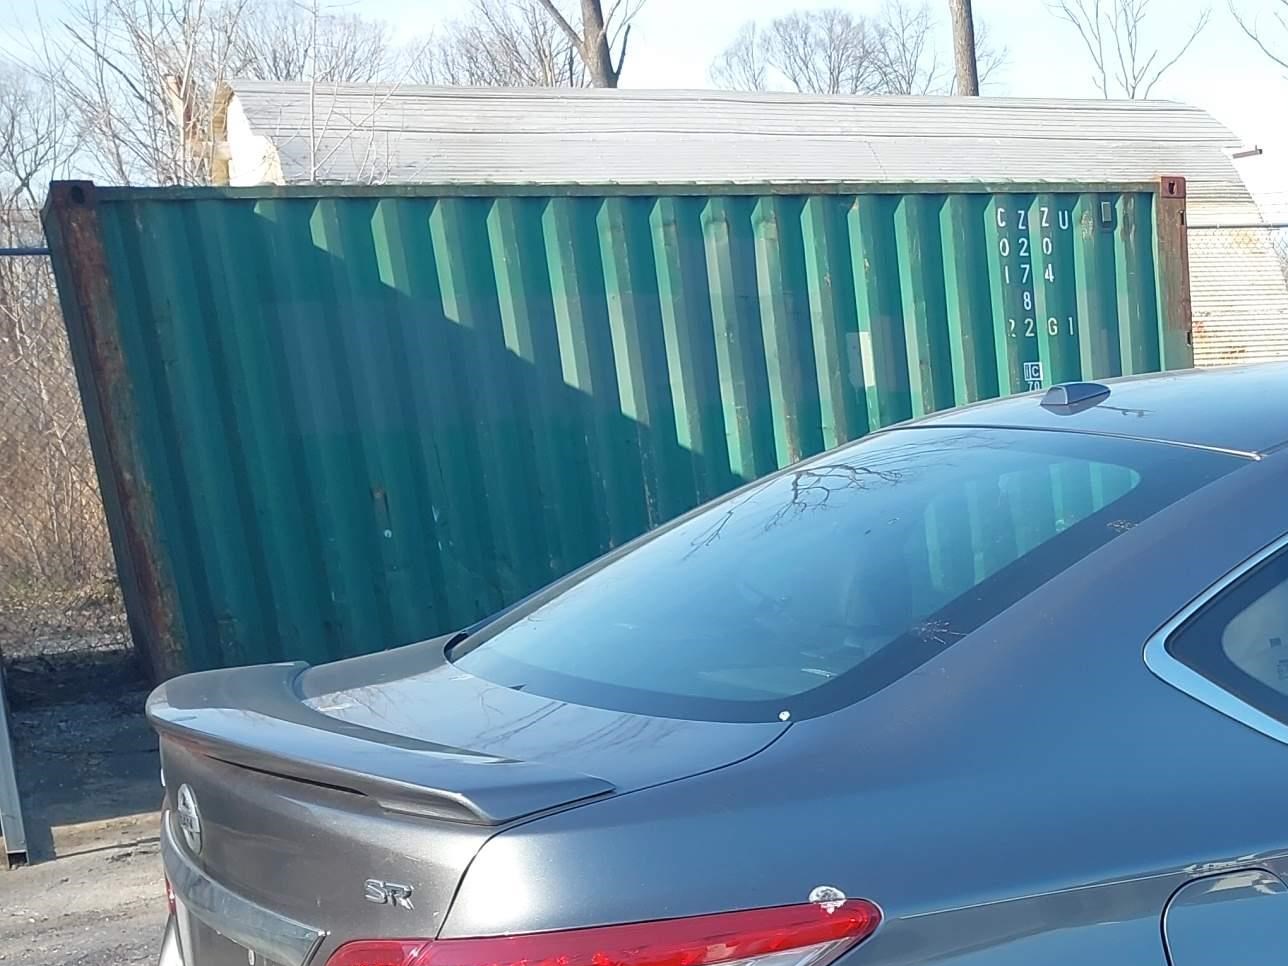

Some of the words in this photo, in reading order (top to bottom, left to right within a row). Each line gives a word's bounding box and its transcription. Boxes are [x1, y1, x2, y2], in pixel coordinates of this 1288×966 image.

[997, 207, 1068, 230] CZZU
[1023, 291, 1032, 311] 8
[365, 879, 415, 910] SR
